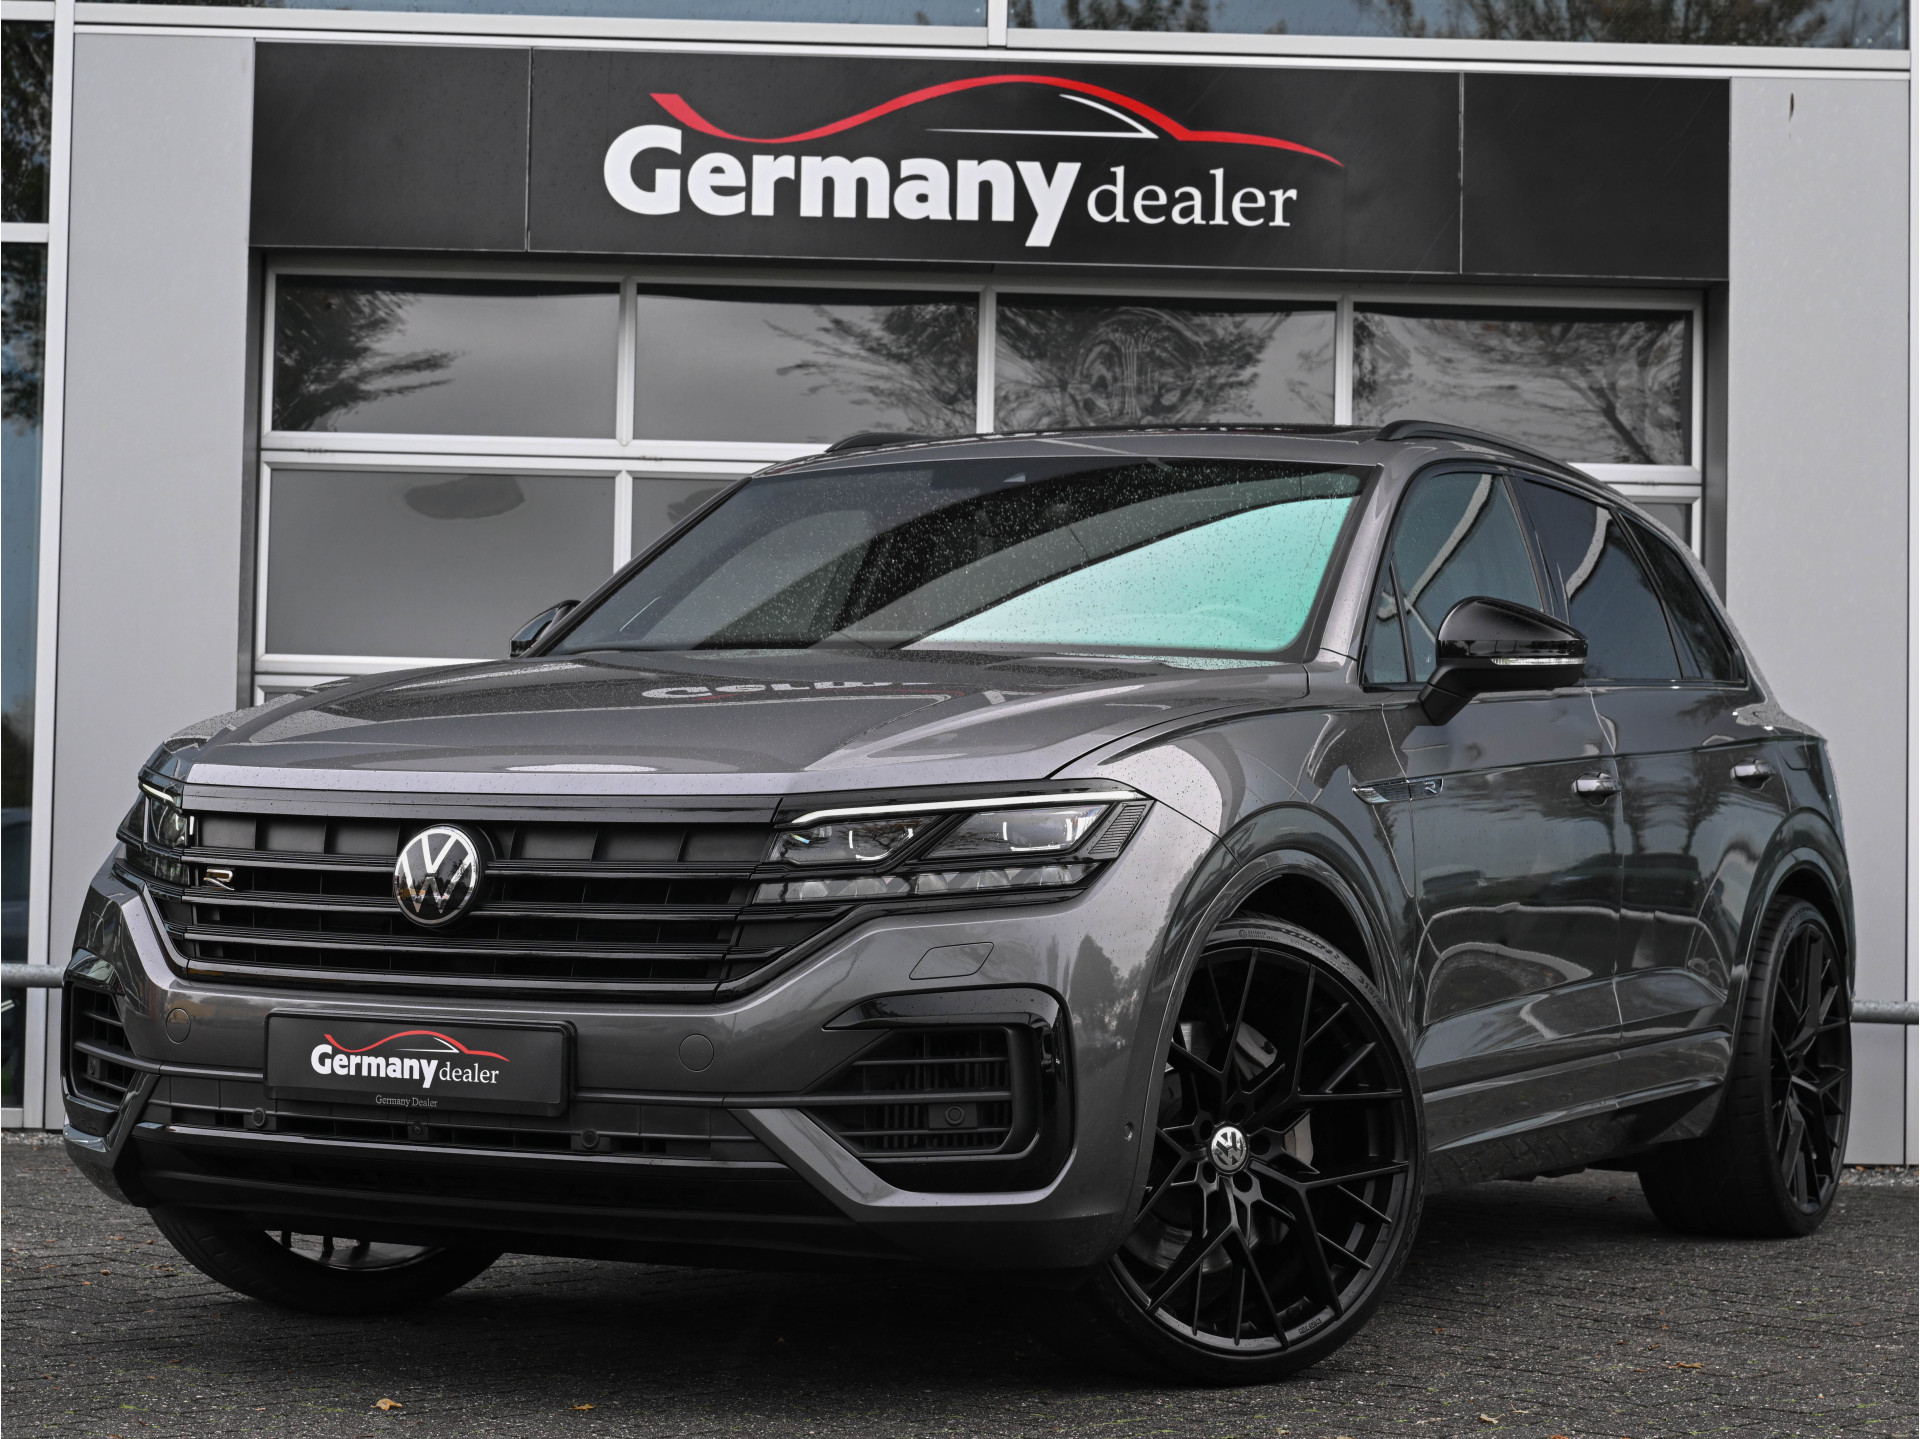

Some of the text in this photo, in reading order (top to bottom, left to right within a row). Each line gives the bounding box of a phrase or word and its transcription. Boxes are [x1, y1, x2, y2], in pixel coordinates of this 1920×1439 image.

[603, 124, 1298, 248] Germany dealer
[310, 1043, 500, 1089] Germany dealer
[375, 1094, 439, 1108] Germany Dealer
